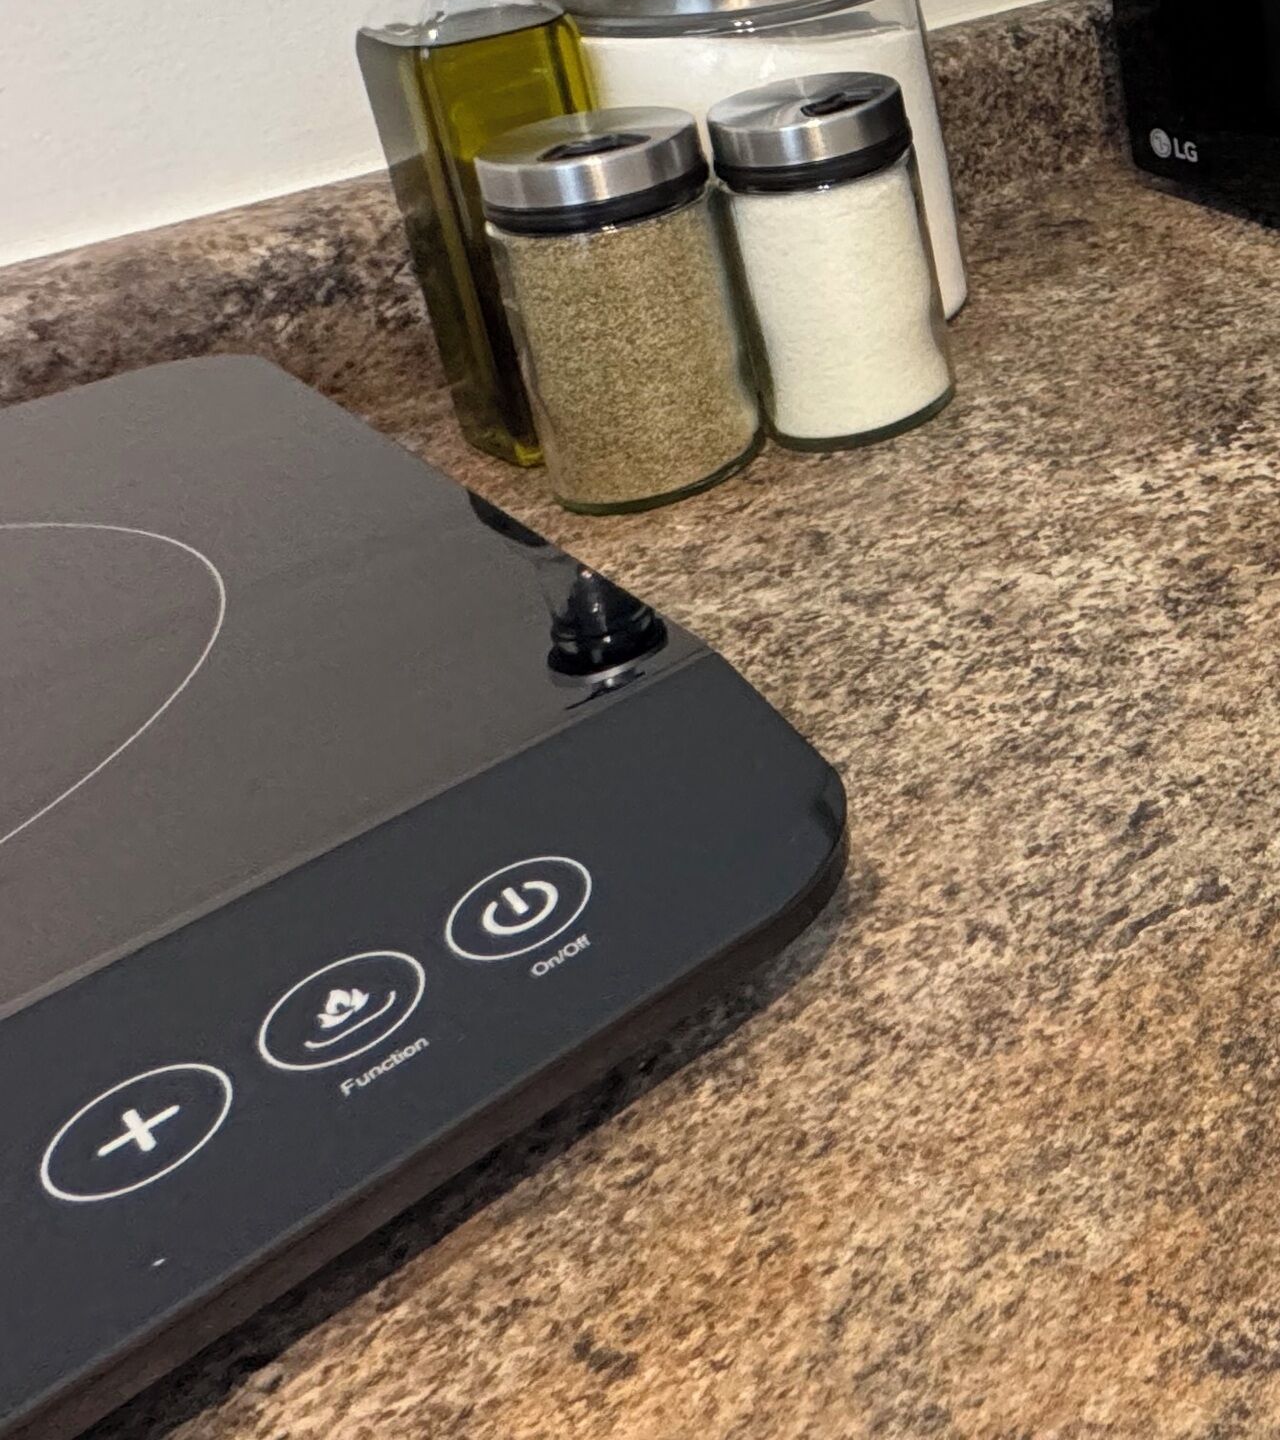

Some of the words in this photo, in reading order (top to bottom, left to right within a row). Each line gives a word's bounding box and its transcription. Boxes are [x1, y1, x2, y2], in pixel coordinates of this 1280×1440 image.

[1173, 137, 1198, 162] LG
[530, 933, 592, 978] On/Off
[339, 1036, 431, 1098] Function
